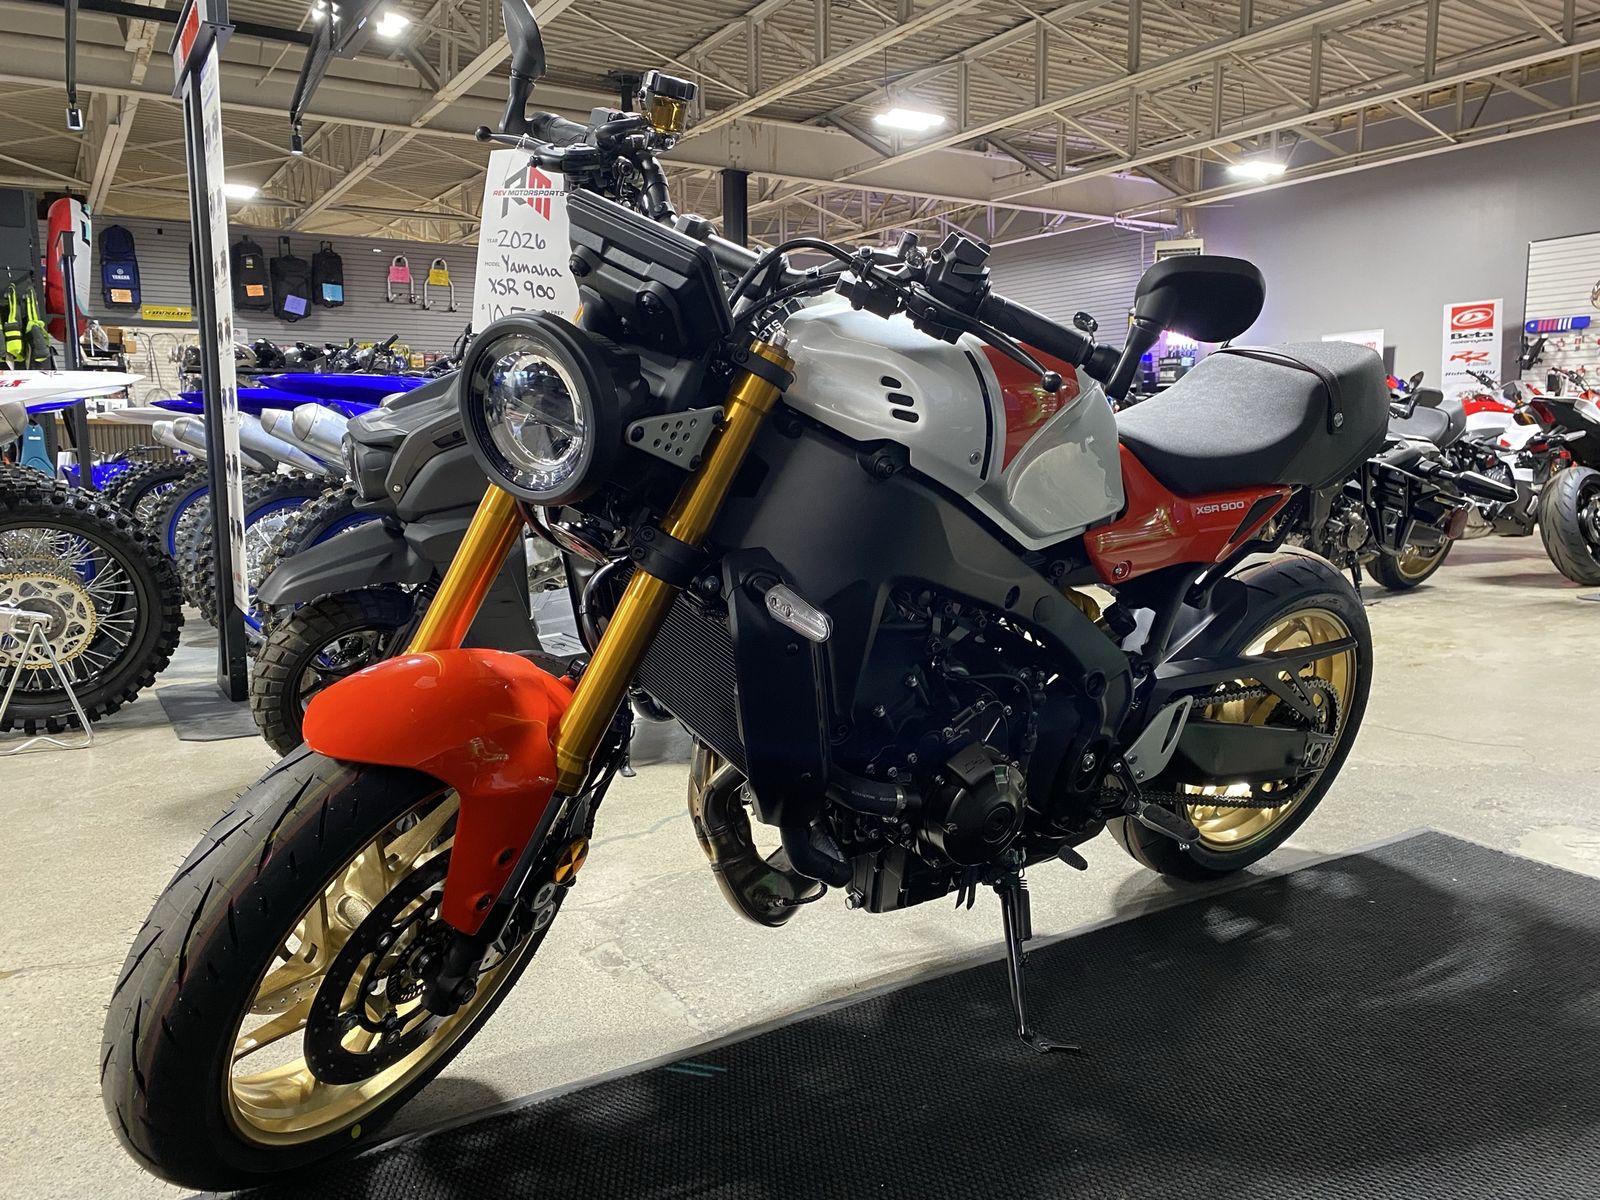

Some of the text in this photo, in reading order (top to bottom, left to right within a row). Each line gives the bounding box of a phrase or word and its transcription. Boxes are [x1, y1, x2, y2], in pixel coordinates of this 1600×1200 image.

[497, 229, 546, 250] 2026
[501, 254, 562, 278] Yamaha
[488, 278, 556, 301] XSR 900
[1450, 331, 1494, 340] Beta
[1196, 501, 1245, 515] XSR 900
